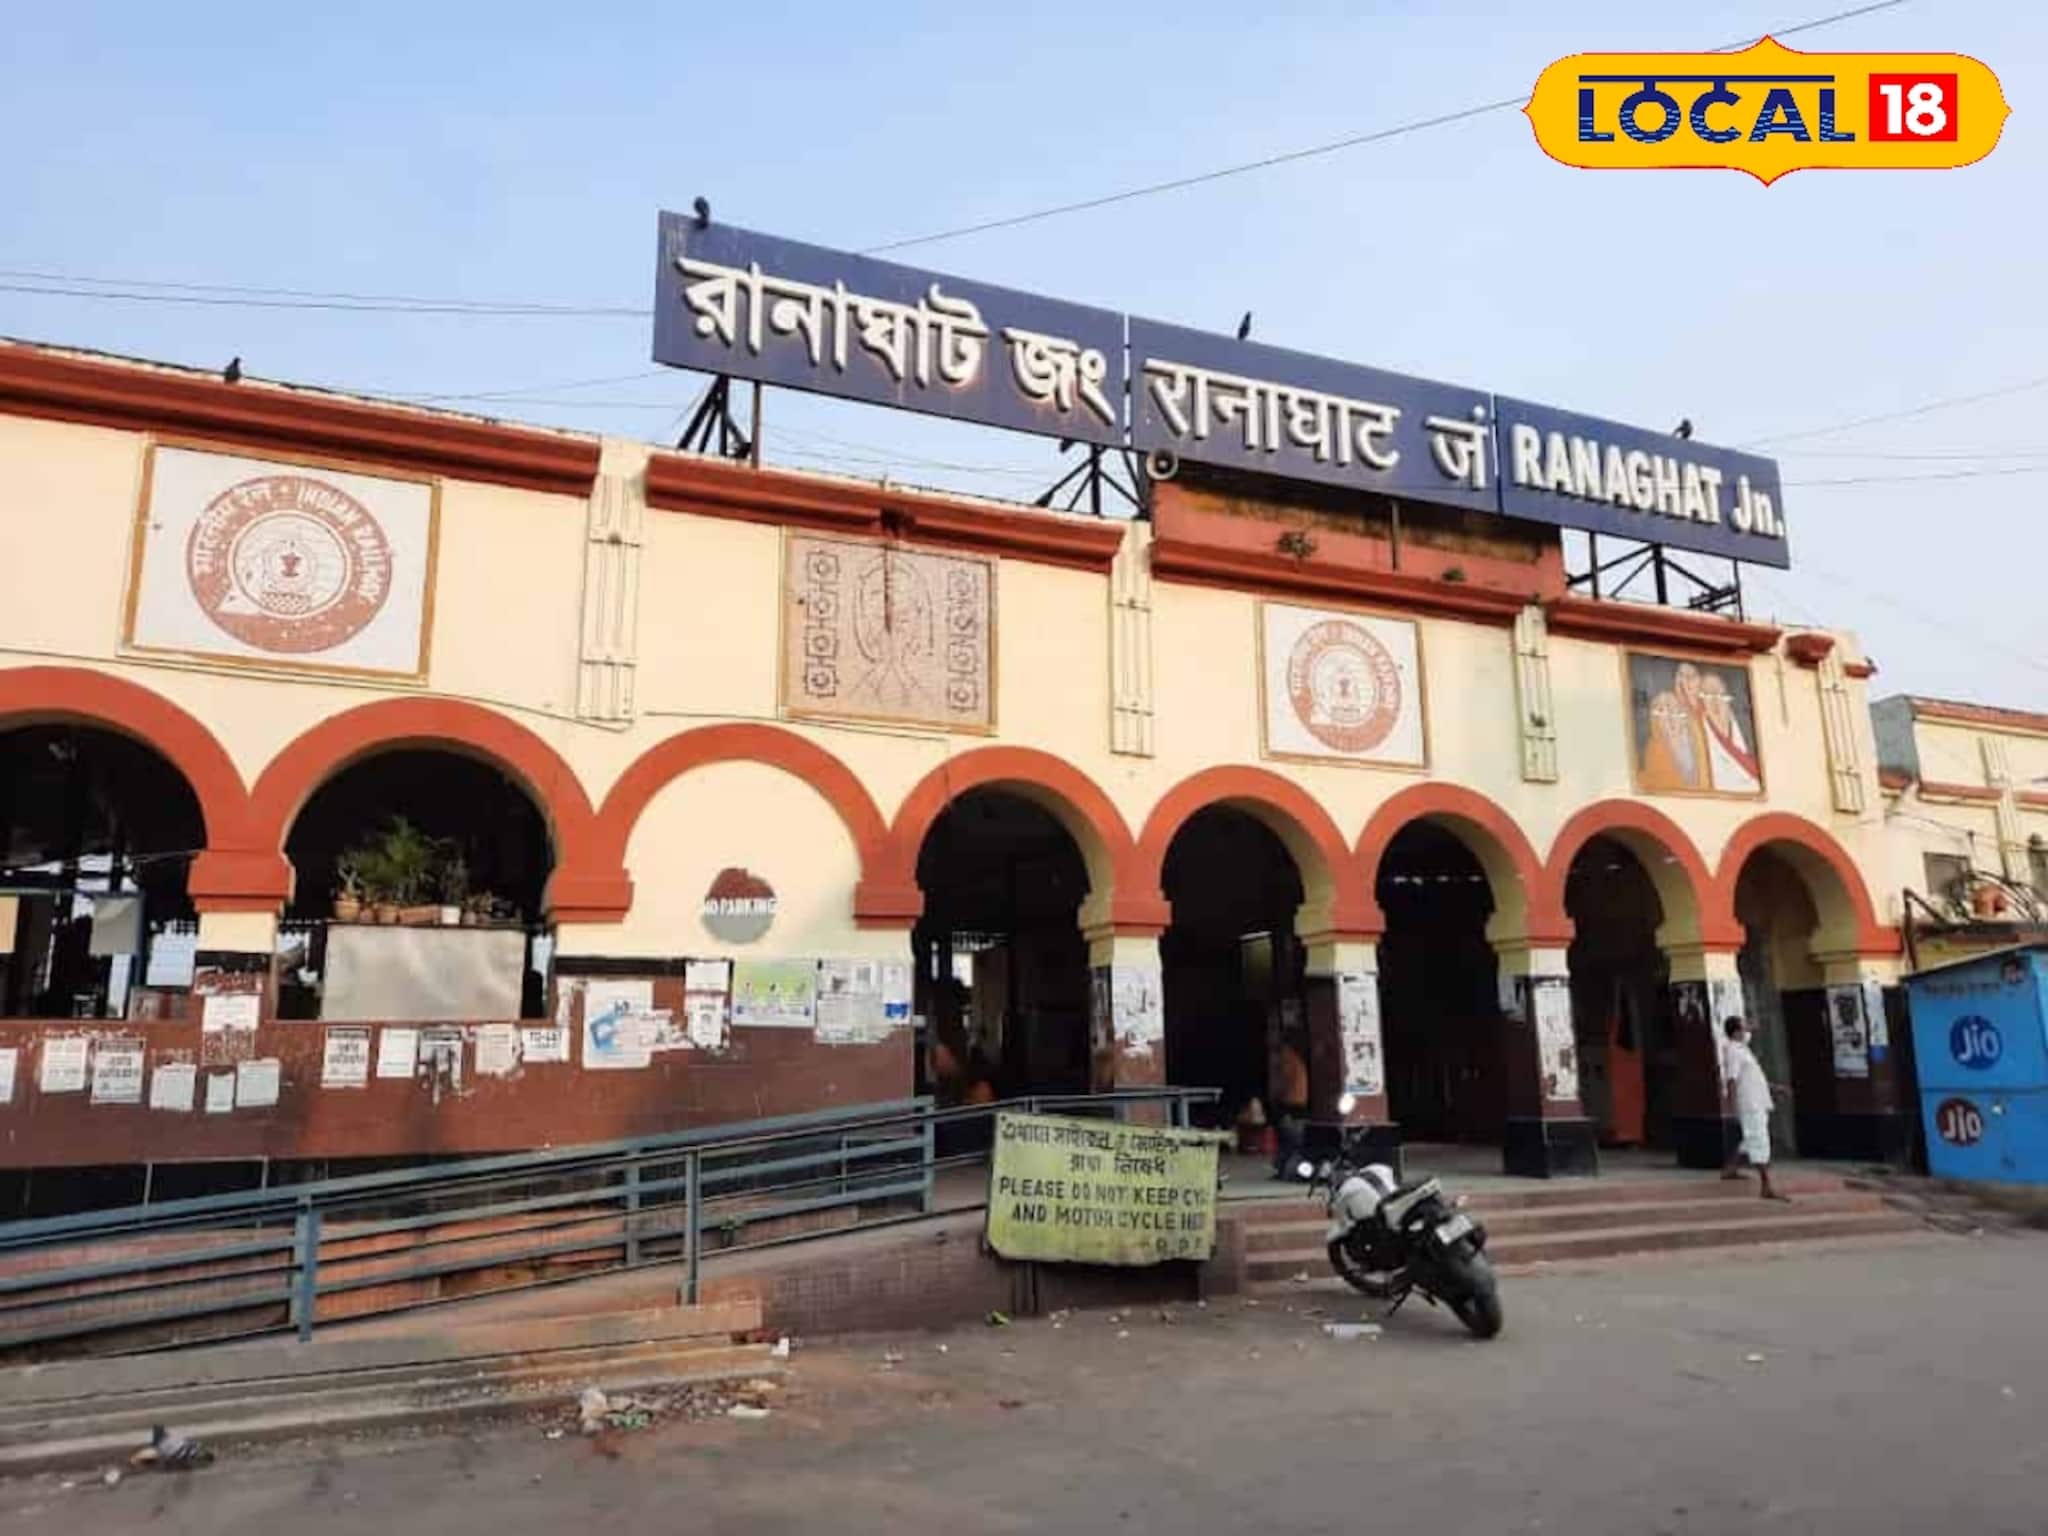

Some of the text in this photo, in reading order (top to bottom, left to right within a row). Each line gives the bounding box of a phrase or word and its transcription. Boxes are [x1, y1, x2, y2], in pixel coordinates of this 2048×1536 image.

[676, 257, 1116, 425] রানাঘাট জং
[1143, 358, 1489, 488] रानाघाट जं
[1510, 423, 1784, 539] RANAGHAT Jn.
[1958, 1023, 2000, 1061] Jio
[1943, 1106, 1983, 1141] Jio
[1000, 1176, 1065, 1199] PLEASE
[1072, 1183, 1090, 1200] DO
[1098, 1185, 1127, 1202] NOT
[1133, 1187, 1178, 1205] KEEP
[1011, 1204, 1047, 1224] AND
